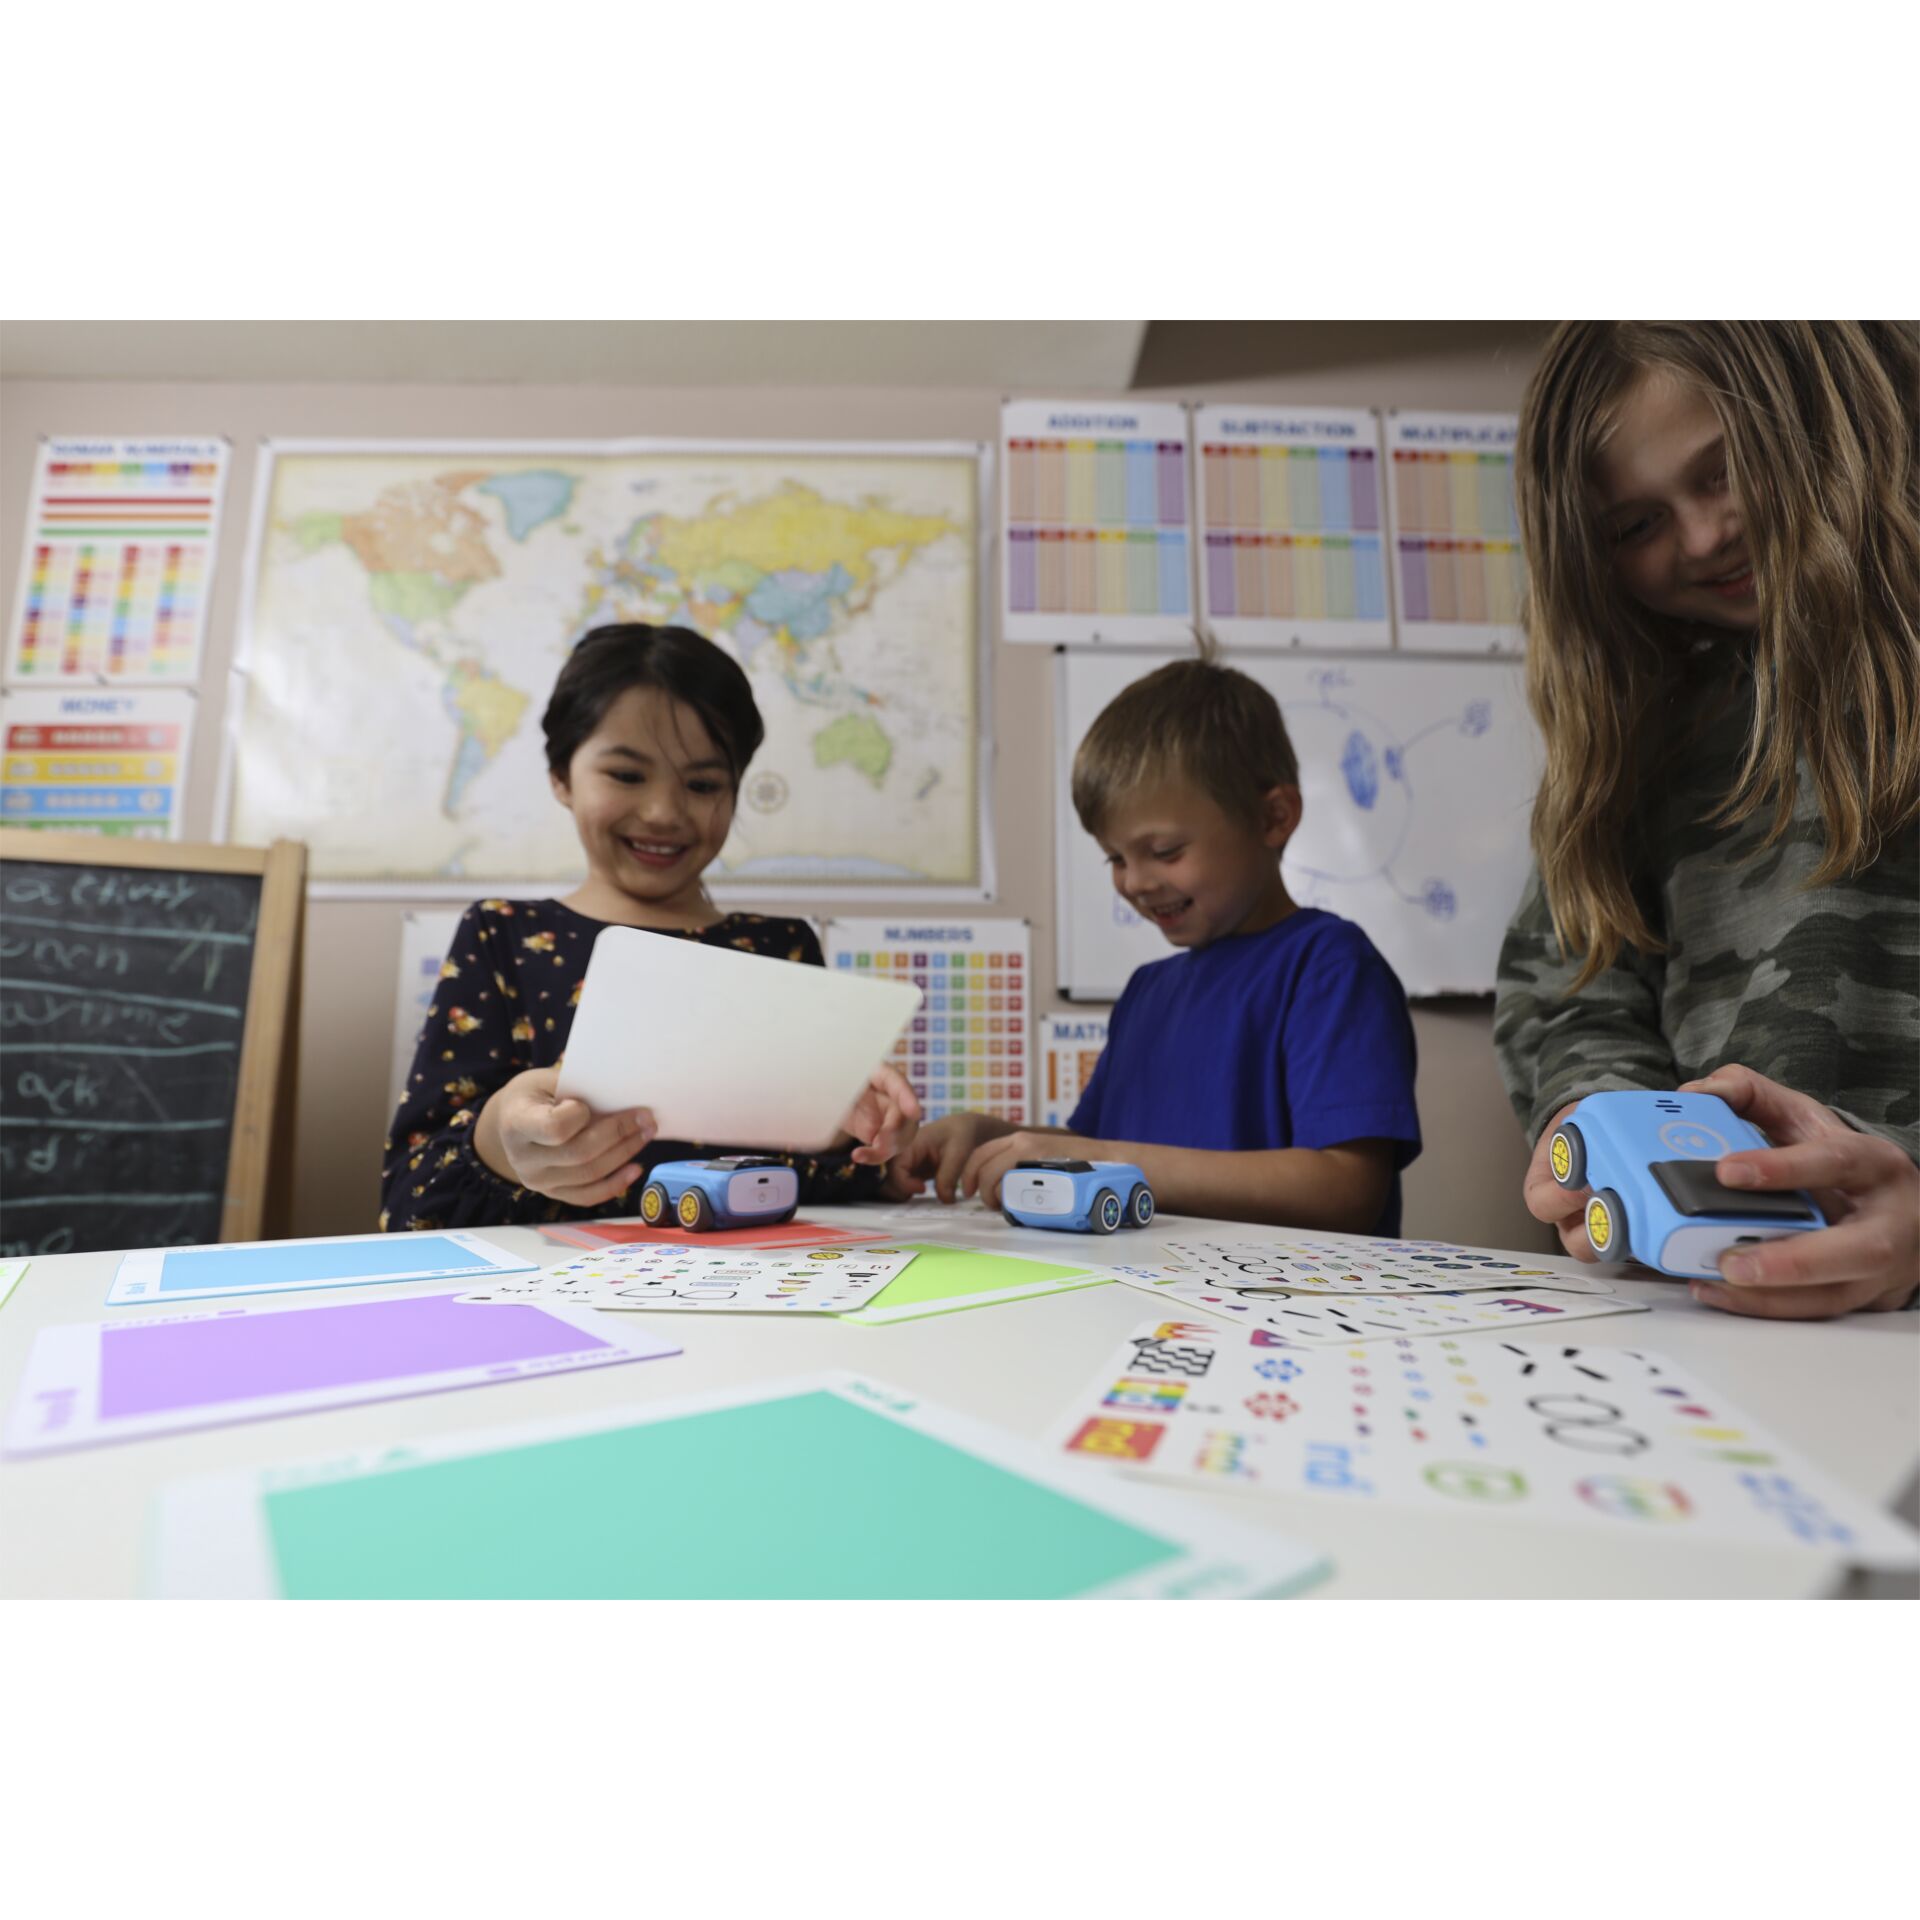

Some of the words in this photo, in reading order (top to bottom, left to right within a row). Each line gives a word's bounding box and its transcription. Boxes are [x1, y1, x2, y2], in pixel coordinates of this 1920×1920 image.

[1047, 415, 1138, 430] ADDITION
[1220, 419, 1356, 438] SUBTRACTION
[60, 698, 135, 714] MONEY
[884, 925, 974, 942] NUMBERS
